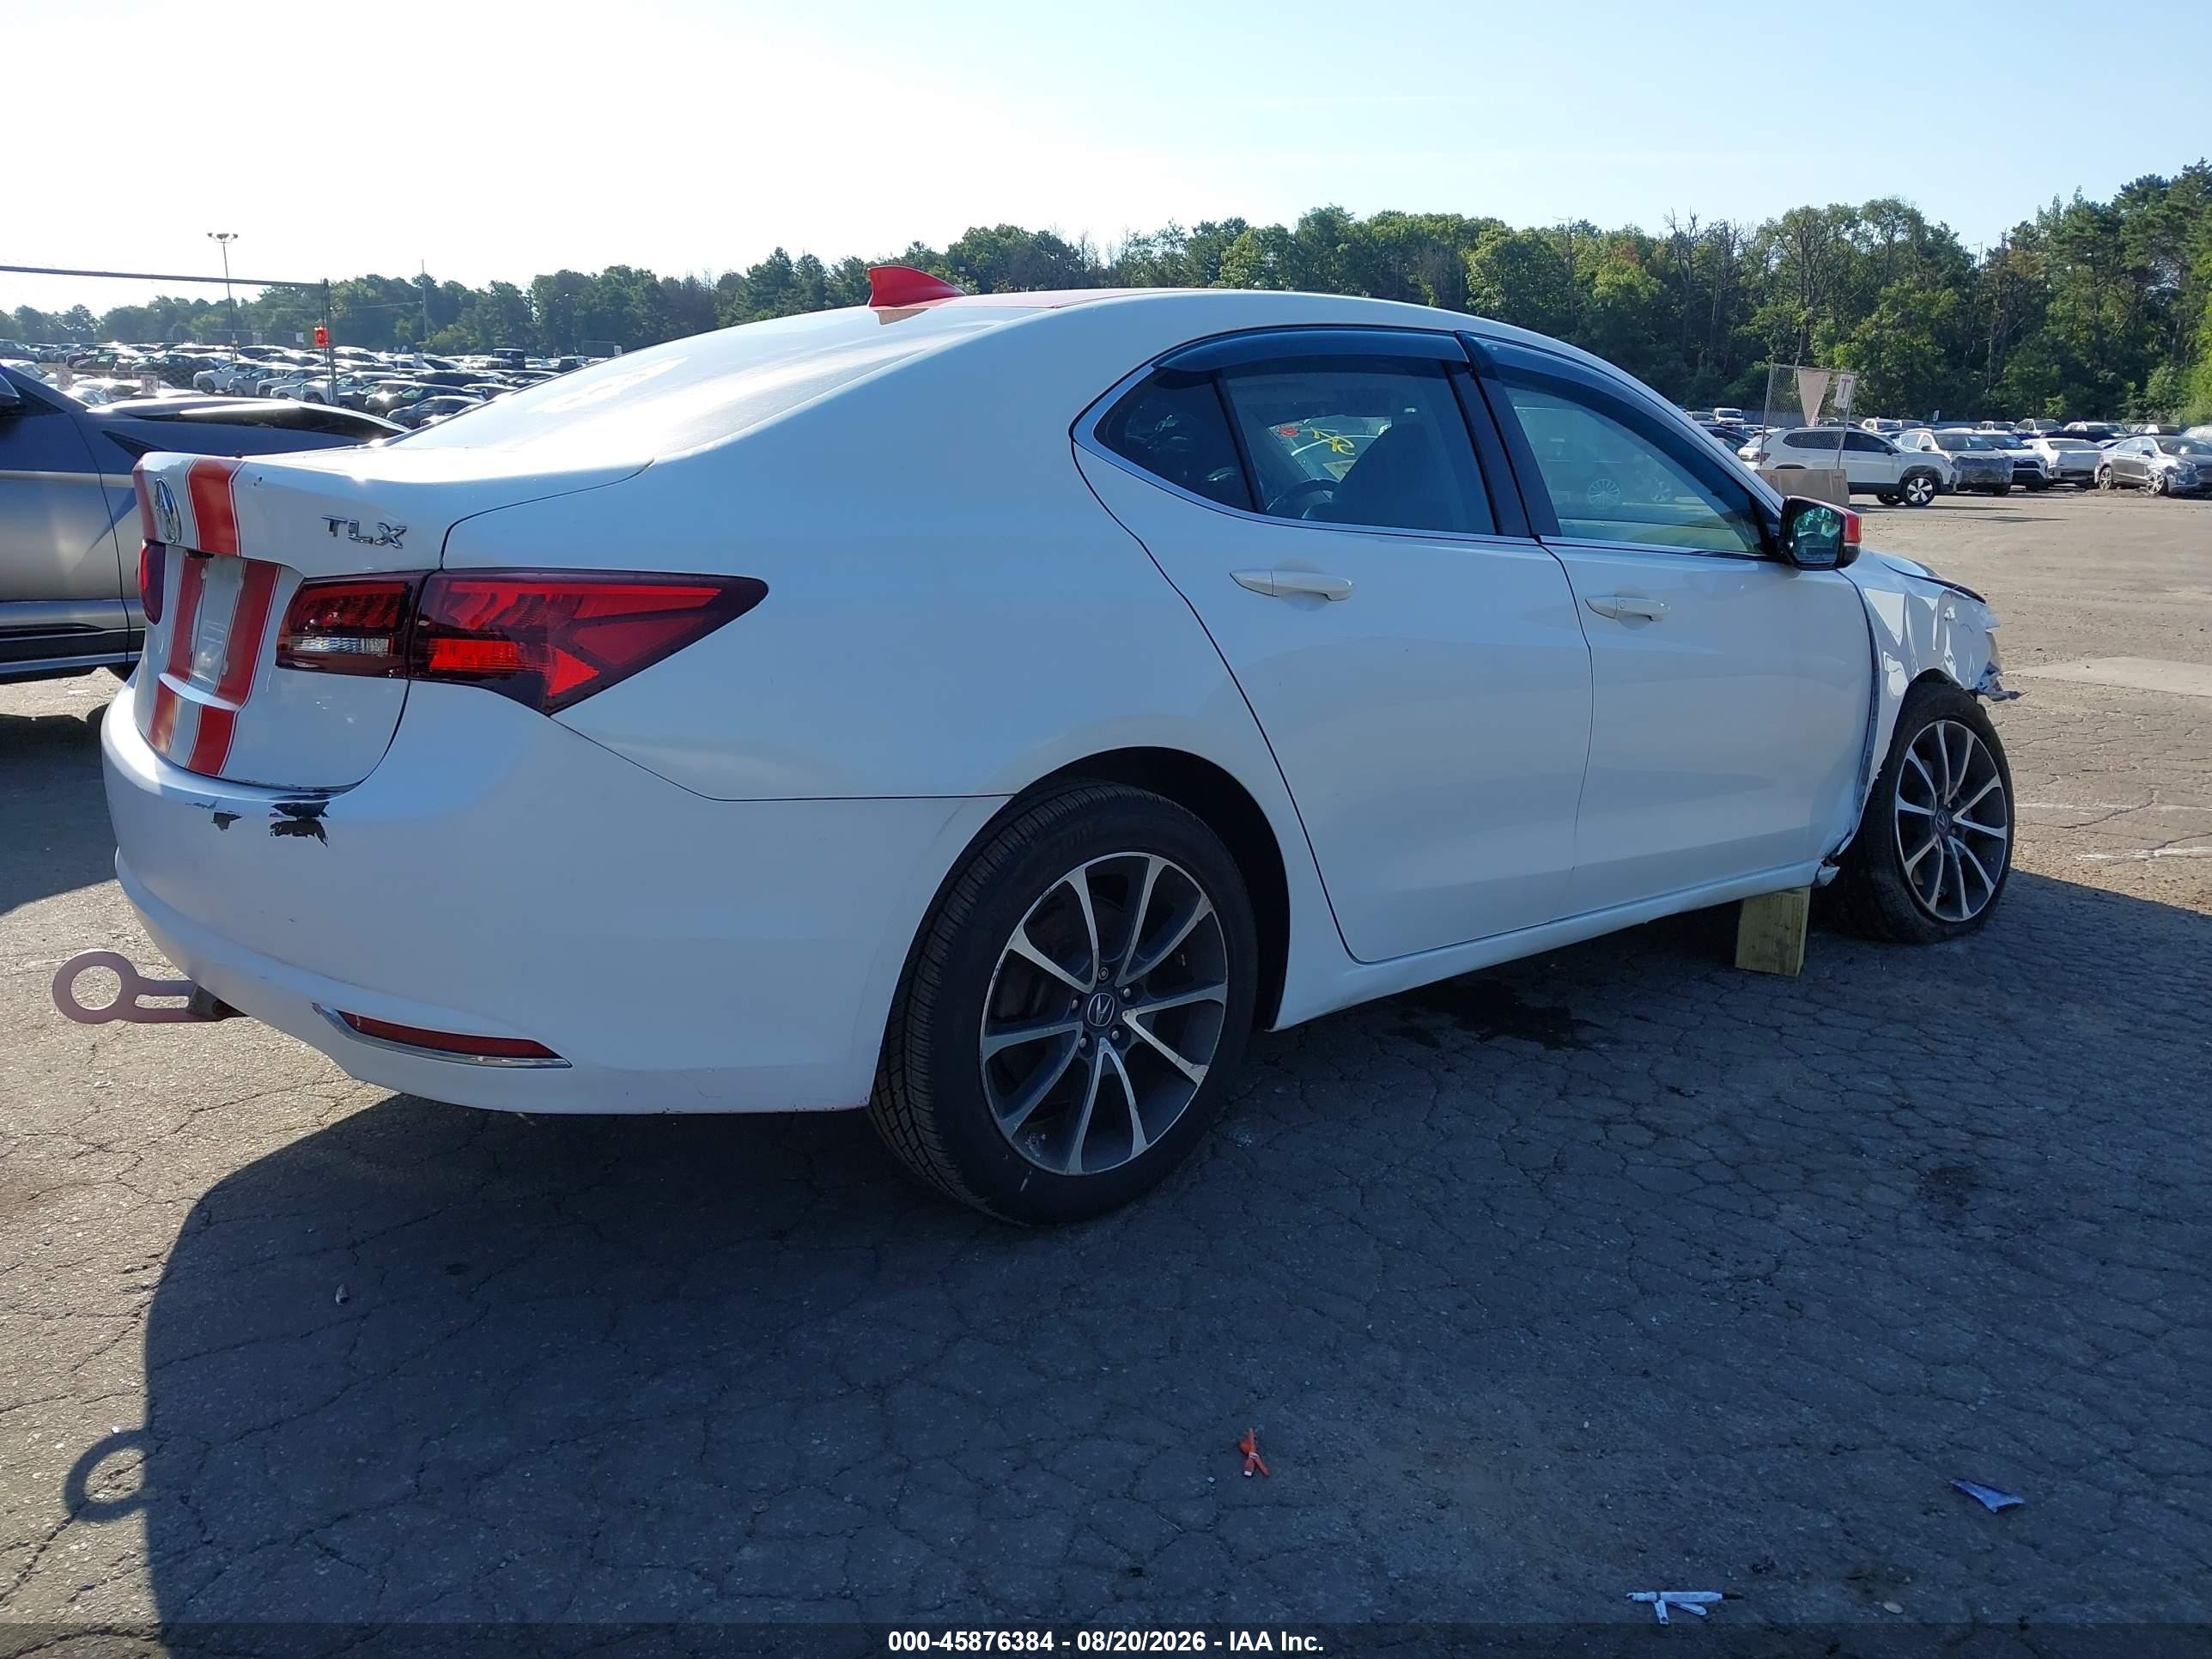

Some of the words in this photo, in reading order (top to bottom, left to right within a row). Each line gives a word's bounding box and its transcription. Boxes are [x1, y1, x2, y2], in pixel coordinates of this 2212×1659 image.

[144, 378, 154, 392] R
[1841, 378, 1851, 399] T
[321, 515, 407, 549] TLX
